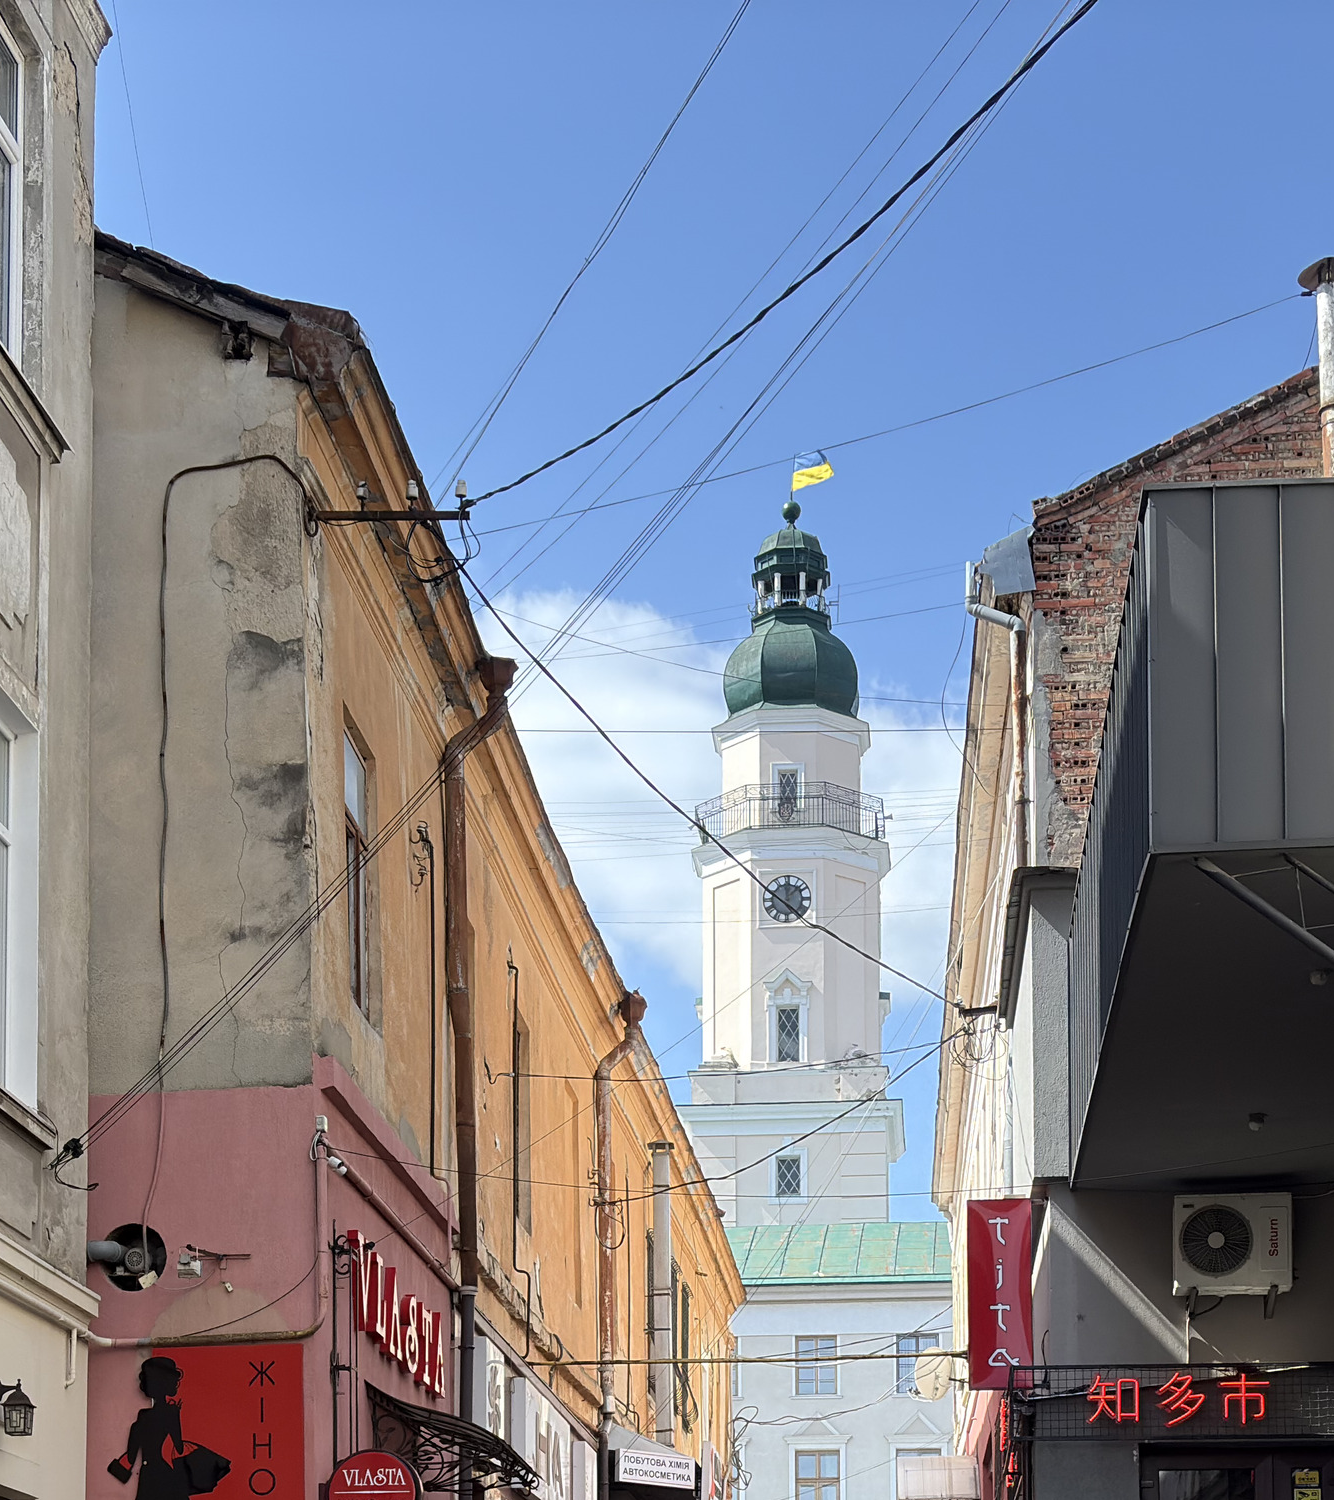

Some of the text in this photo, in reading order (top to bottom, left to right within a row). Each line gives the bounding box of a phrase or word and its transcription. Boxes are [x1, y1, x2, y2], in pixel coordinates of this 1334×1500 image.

[1268, 1218, 1279, 1257] Saturn
[348, 1230, 446, 1398] VLASTA
[1086, 1372, 1269, 1427] 知多市
[341, 1467, 407, 1488] VLASTA
[622, 1467, 692, 1482] АВТОКОСМЕТИКА
[624, 1455, 690, 1470] ПОБУТОВА ХІМІЯ
